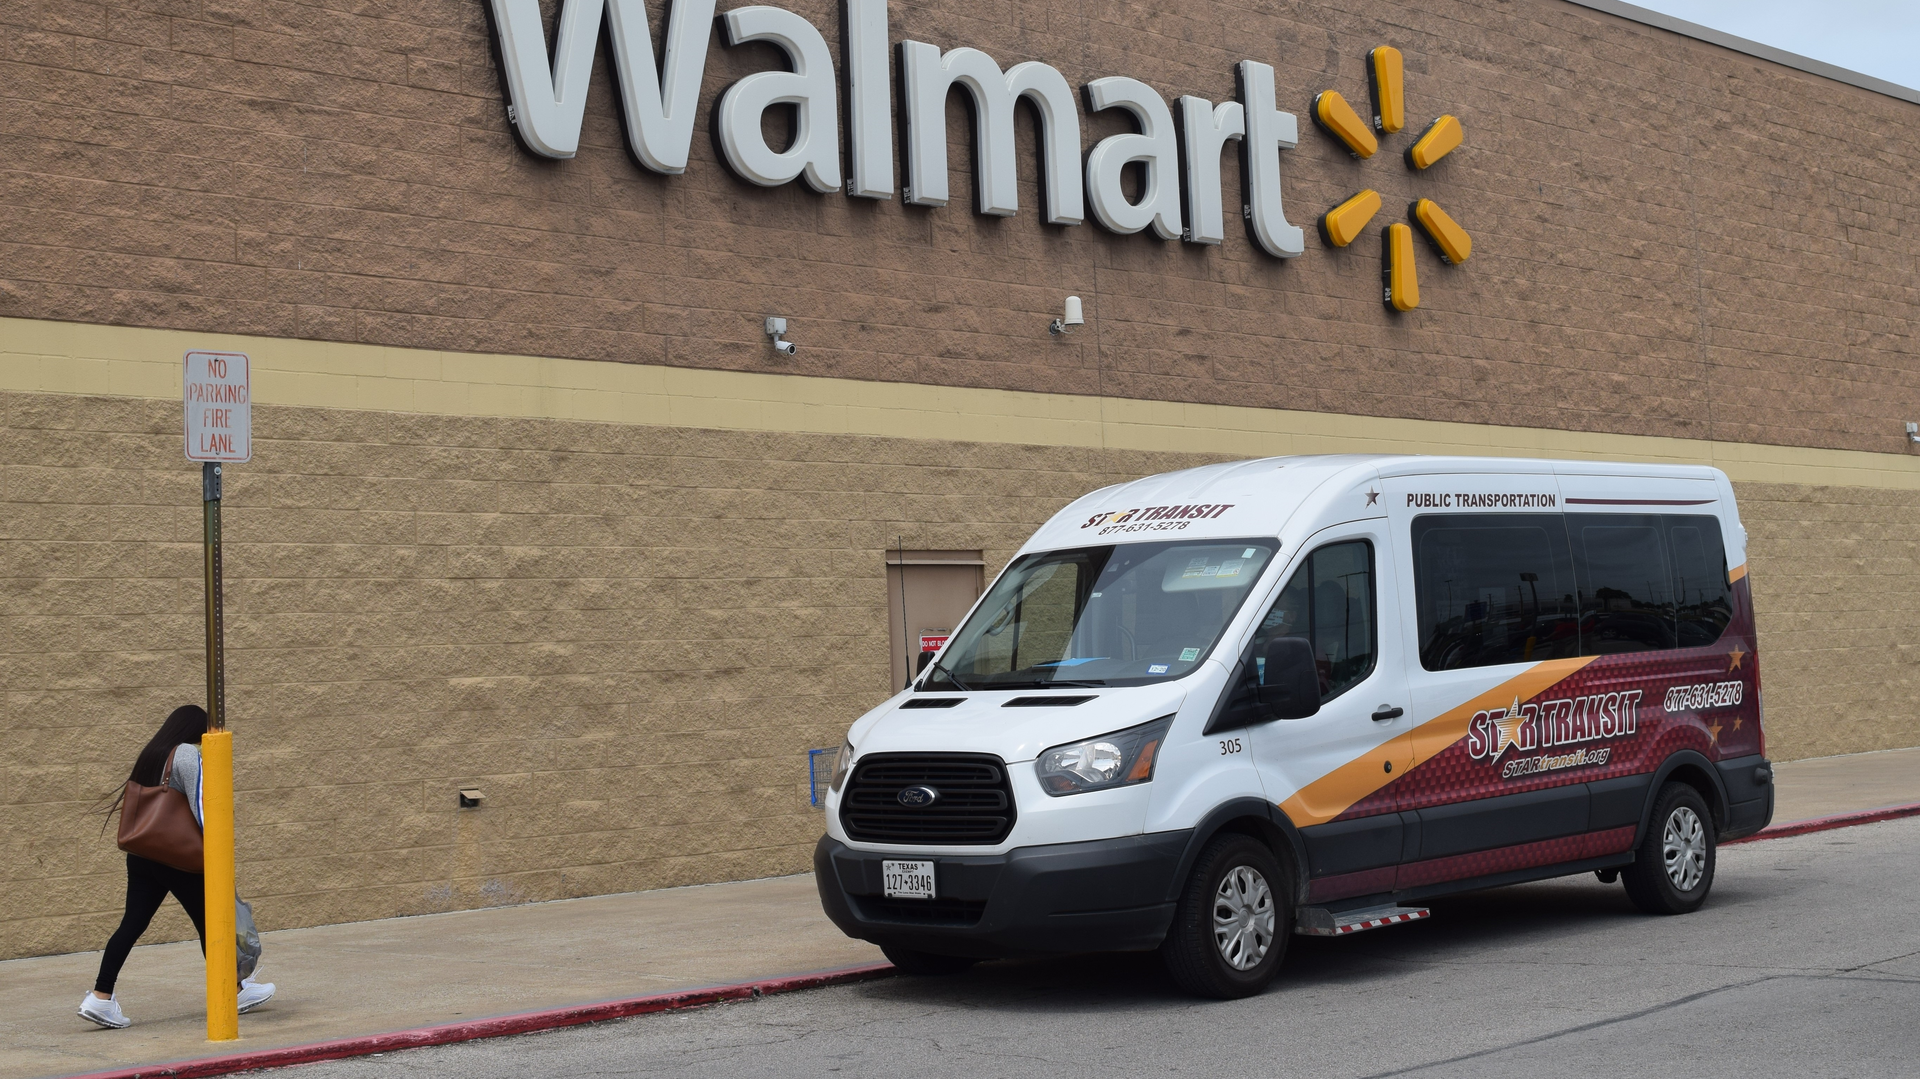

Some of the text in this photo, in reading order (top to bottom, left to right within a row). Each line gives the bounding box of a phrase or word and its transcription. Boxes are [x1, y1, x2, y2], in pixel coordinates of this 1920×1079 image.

[488, 0, 1304, 258] Walmart
[207, 359, 228, 379] NO
[189, 383, 246, 404] PARKING
[203, 408, 232, 428] FIRE
[200, 433, 236, 453] LANE
[1406, 493, 1556, 507] PUBLIC TRANSPORTATION
[1098, 521, 1191, 535] 877-631-5278
[1664, 681, 1743, 712] 877-631-5278
[1219, 738, 1242, 755] 305
[1502, 748, 1611, 778] STARtransit.org
[903, 790, 924, 803] Ford
